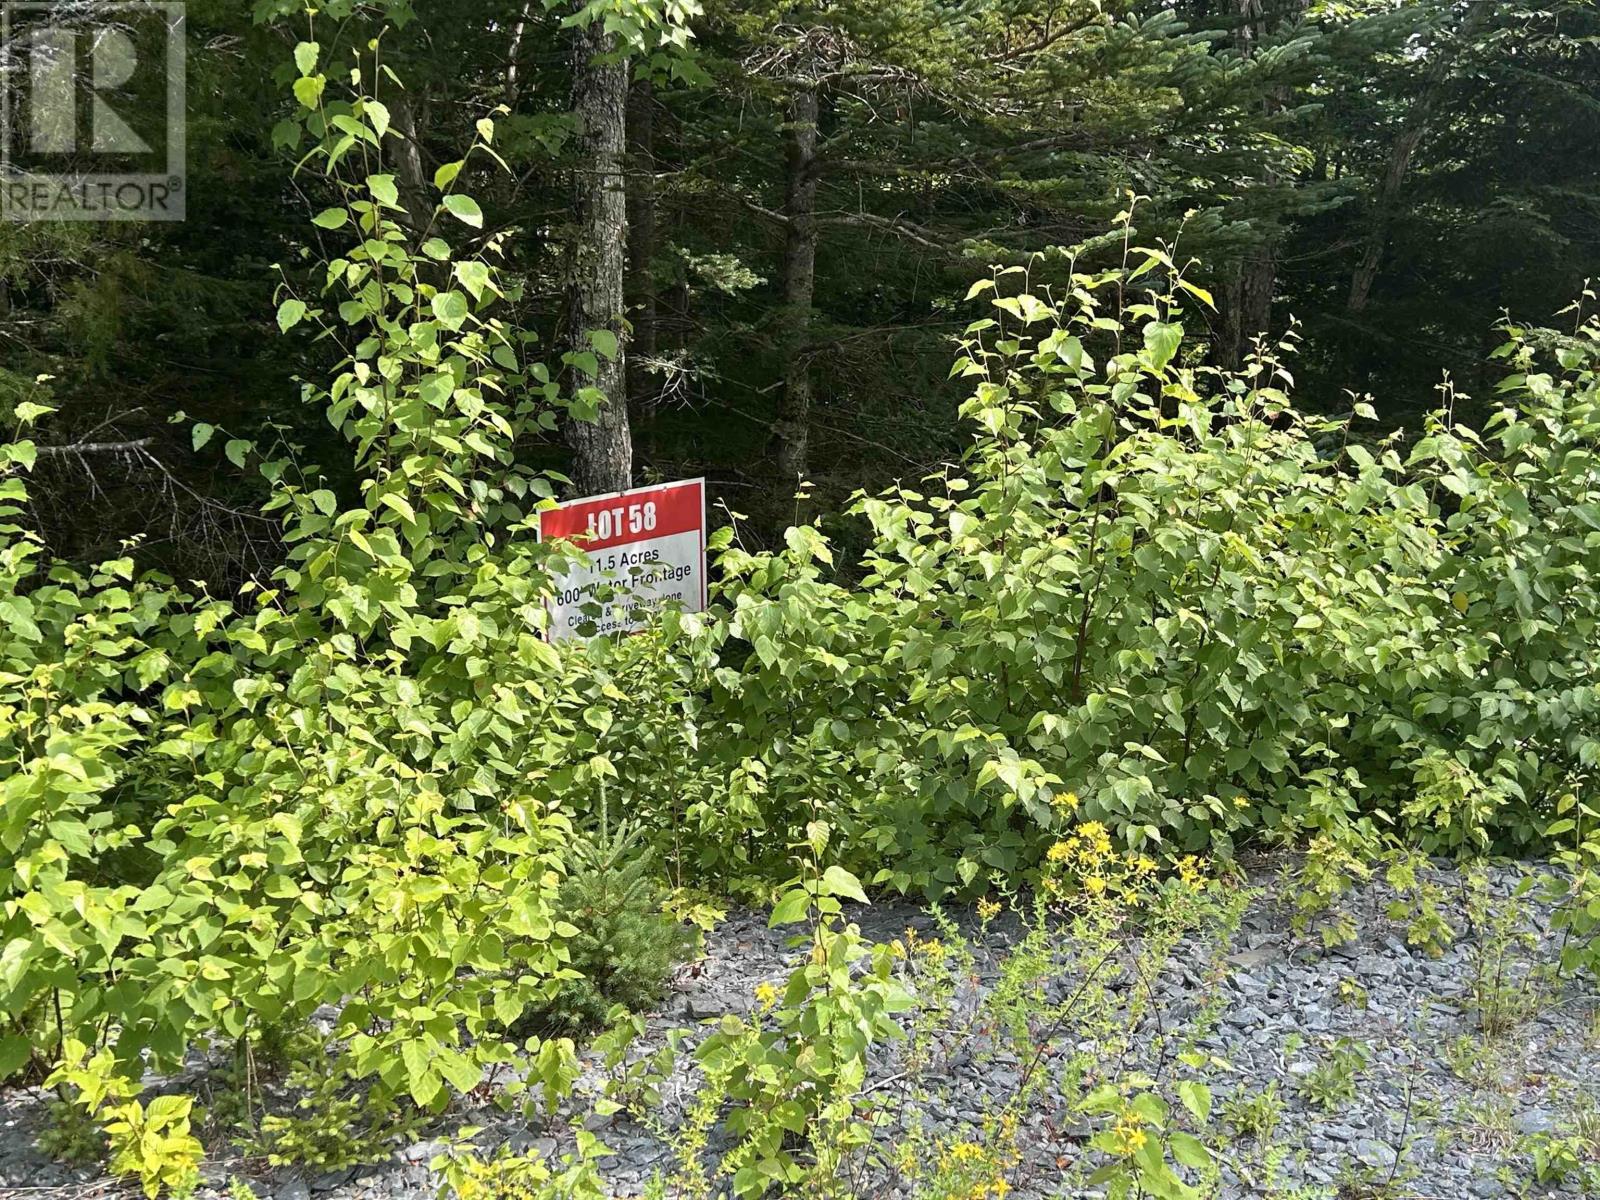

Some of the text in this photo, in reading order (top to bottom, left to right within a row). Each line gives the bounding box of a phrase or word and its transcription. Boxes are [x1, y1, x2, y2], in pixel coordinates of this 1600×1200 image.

[588, 501, 657, 542] LOT 58
[620, 549, 660, 567] Acres
[588, 578, 627, 597] Wter
[606, 606, 612, 617] &
[663, 592, 682, 601] one
